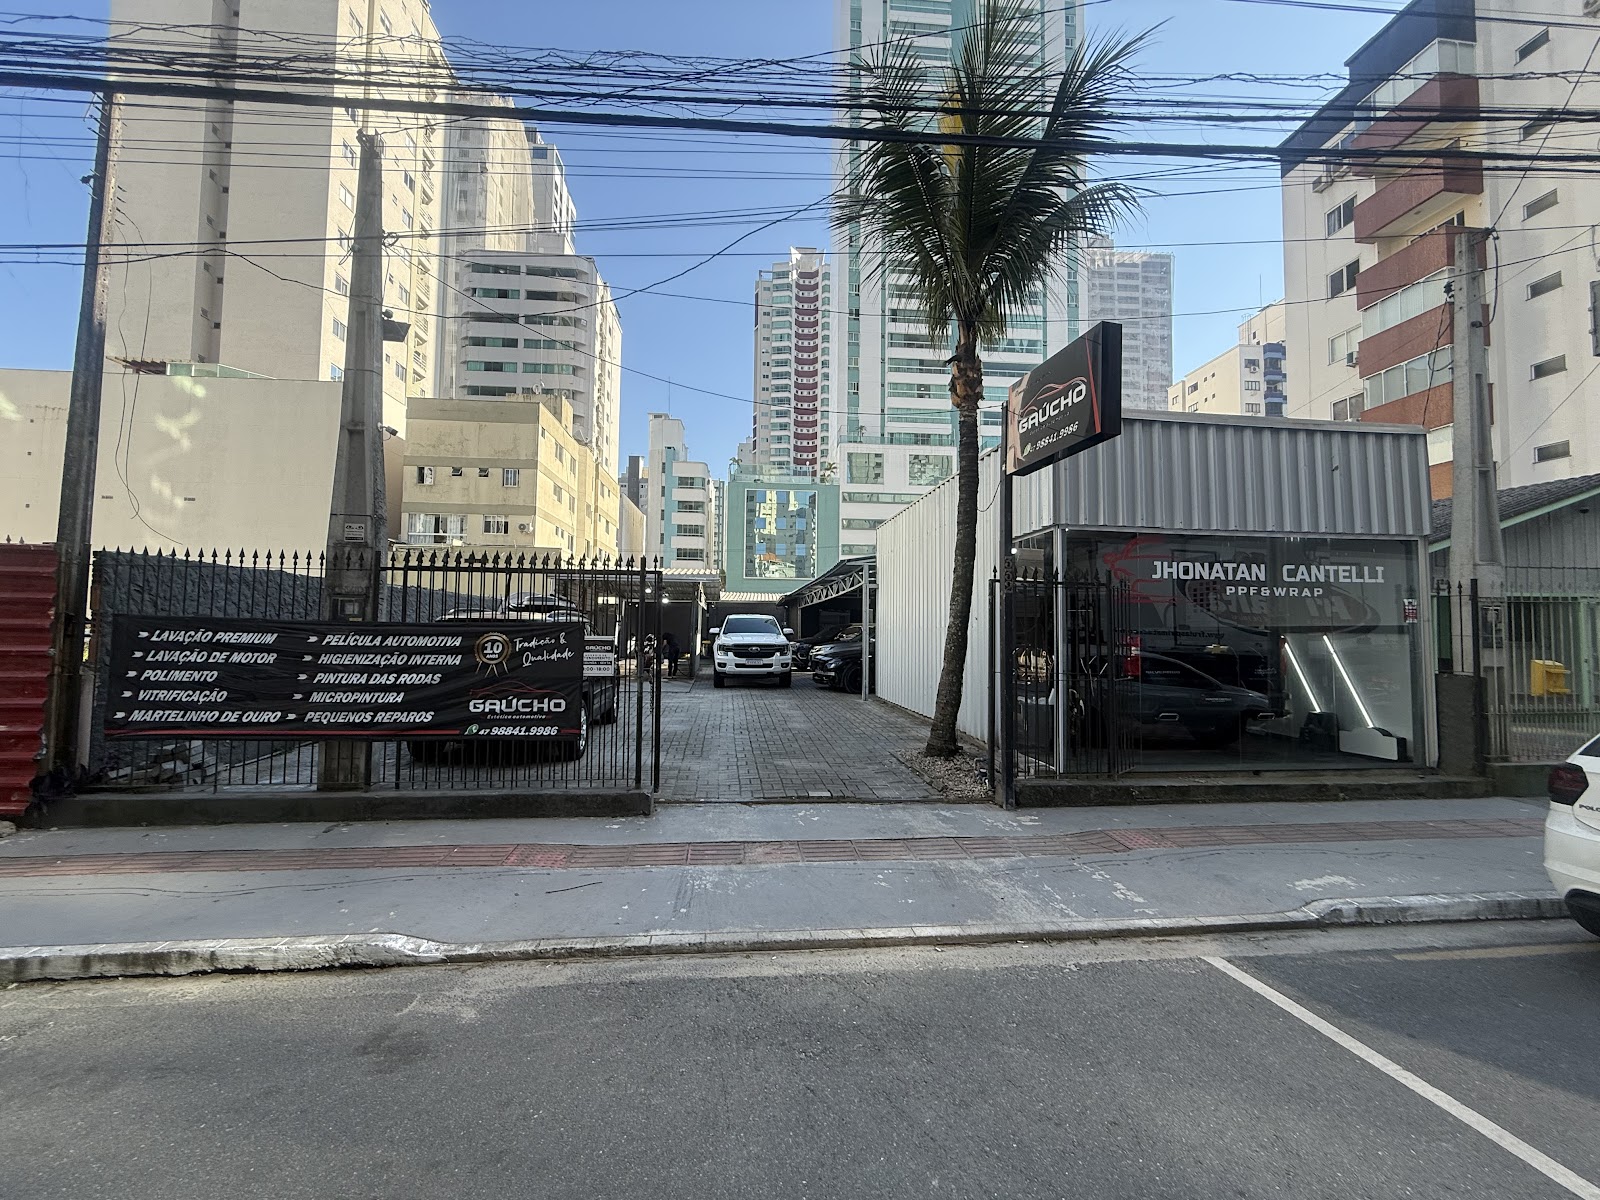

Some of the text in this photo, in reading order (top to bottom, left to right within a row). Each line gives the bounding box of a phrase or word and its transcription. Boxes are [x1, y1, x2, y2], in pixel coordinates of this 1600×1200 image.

[1018, 383, 1087, 434] GAÚCHO
[1151, 560, 1384, 583] JHONATAN CANTELLI
[1225, 586, 1323, 597] PPF&WRAP
[150, 629, 278, 645] LAVAÇÃO PREMIUM
[322, 632, 462, 647] PELÍCULA AUTOMOTIVA
[513, 632, 568, 652] Tradição &
[483, 642, 503, 654] 10
[145, 649, 278, 665] LAVAÇÃO DE MOTOR
[317, 651, 463, 668] HIGIENIZAÇÃO INTERNA
[522, 647, 575, 667] Qualidade
[140, 670, 218, 682] POLIMENTO
[313, 673, 442, 684] PINTURA DAS RODAS
[137, 688, 228, 705] VITRIFICAÇÃO
[309, 691, 405, 703] MICROPINTURA
[469, 695, 566, 714] GAÚCHO
[128, 710, 282, 723] MARTELINHO DE OURO
[304, 711, 435, 724] PEQUENOS REPAROS
[490, 726, 559, 735] 98841.9986
